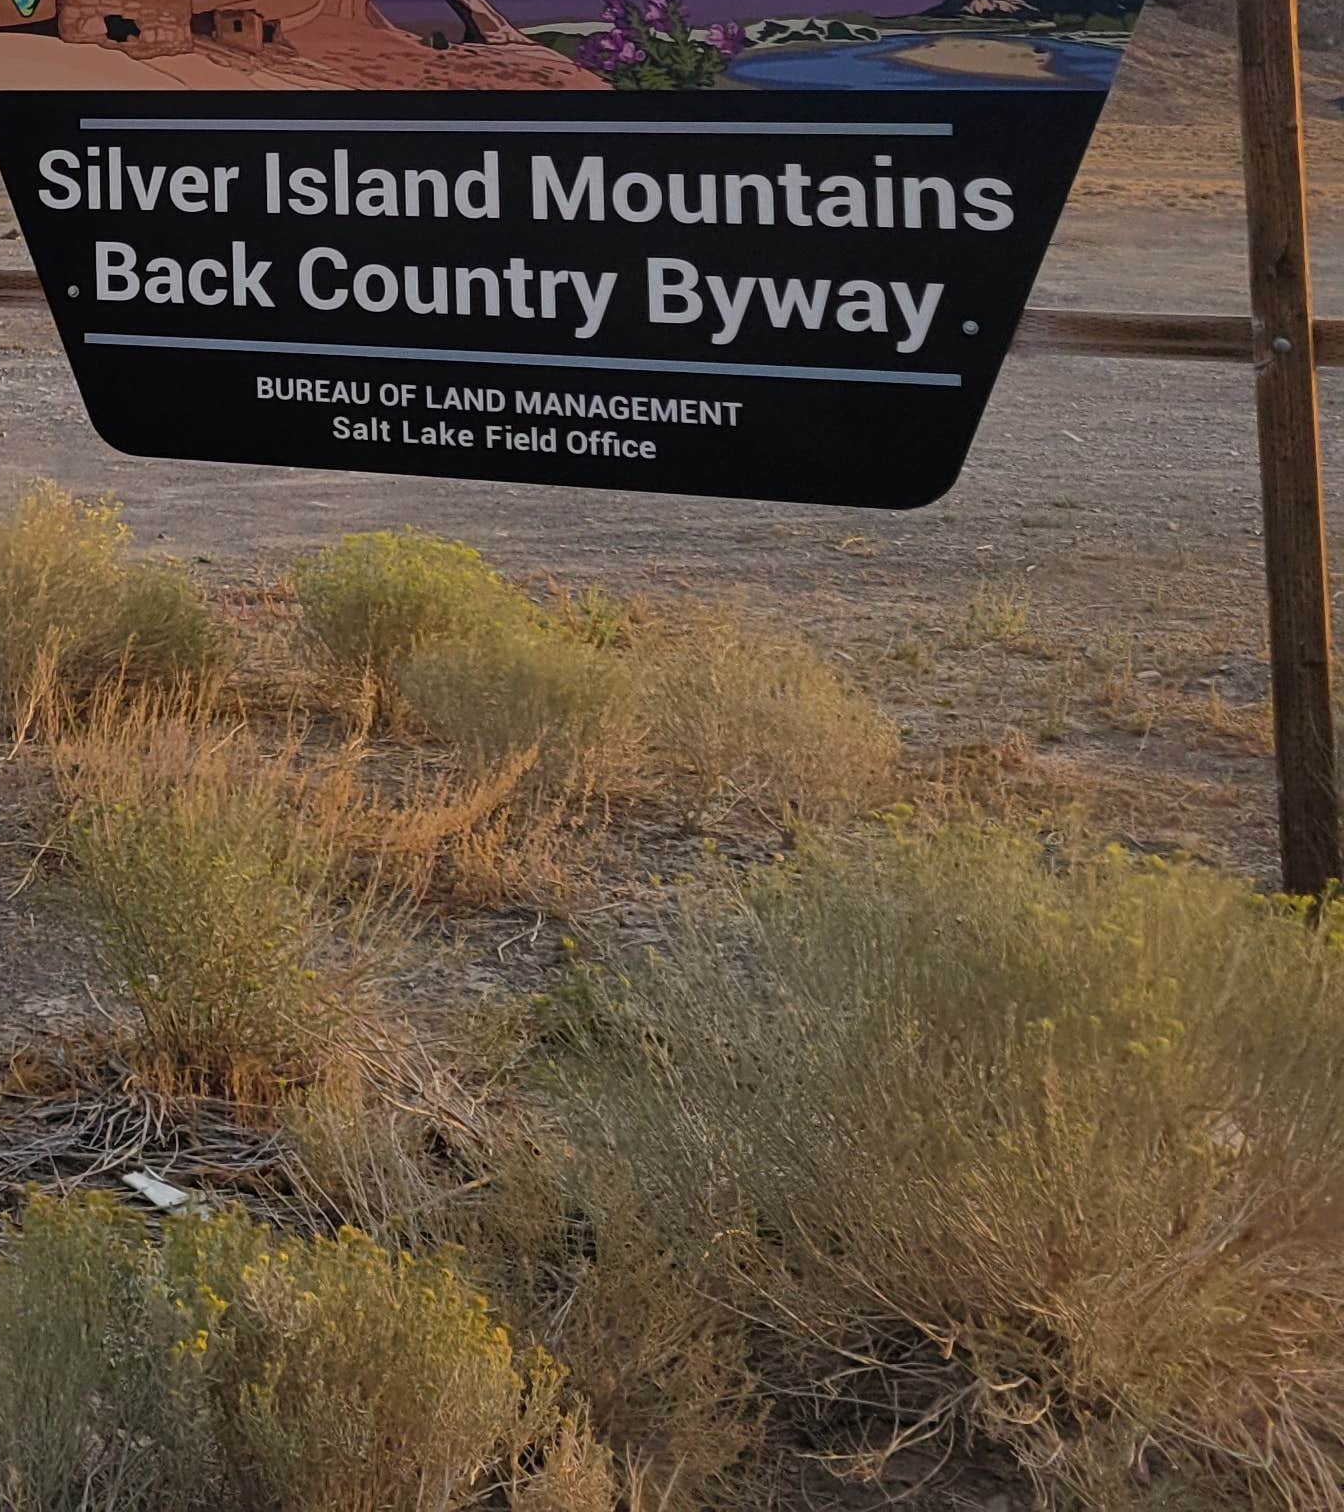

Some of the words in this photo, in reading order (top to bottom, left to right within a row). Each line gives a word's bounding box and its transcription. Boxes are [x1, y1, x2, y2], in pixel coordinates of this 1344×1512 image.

[37, 146, 239, 213] Silver
[265, 148, 500, 219] Island
[531, 152, 1014, 231] Mountains
[95, 240, 275, 308] Back
[298, 246, 618, 339] Country
[647, 257, 945, 354] Byway
[256, 376, 370, 405] BUREAU
[379, 383, 417, 407] OF
[426, 385, 506, 413] LAND
[515, 390, 743, 427] MANAGEMENT
[332, 416, 391, 442] Salt
[402, 420, 474, 448] Lake
[486, 425, 557, 453] Field
[566, 430, 657, 459] Office
